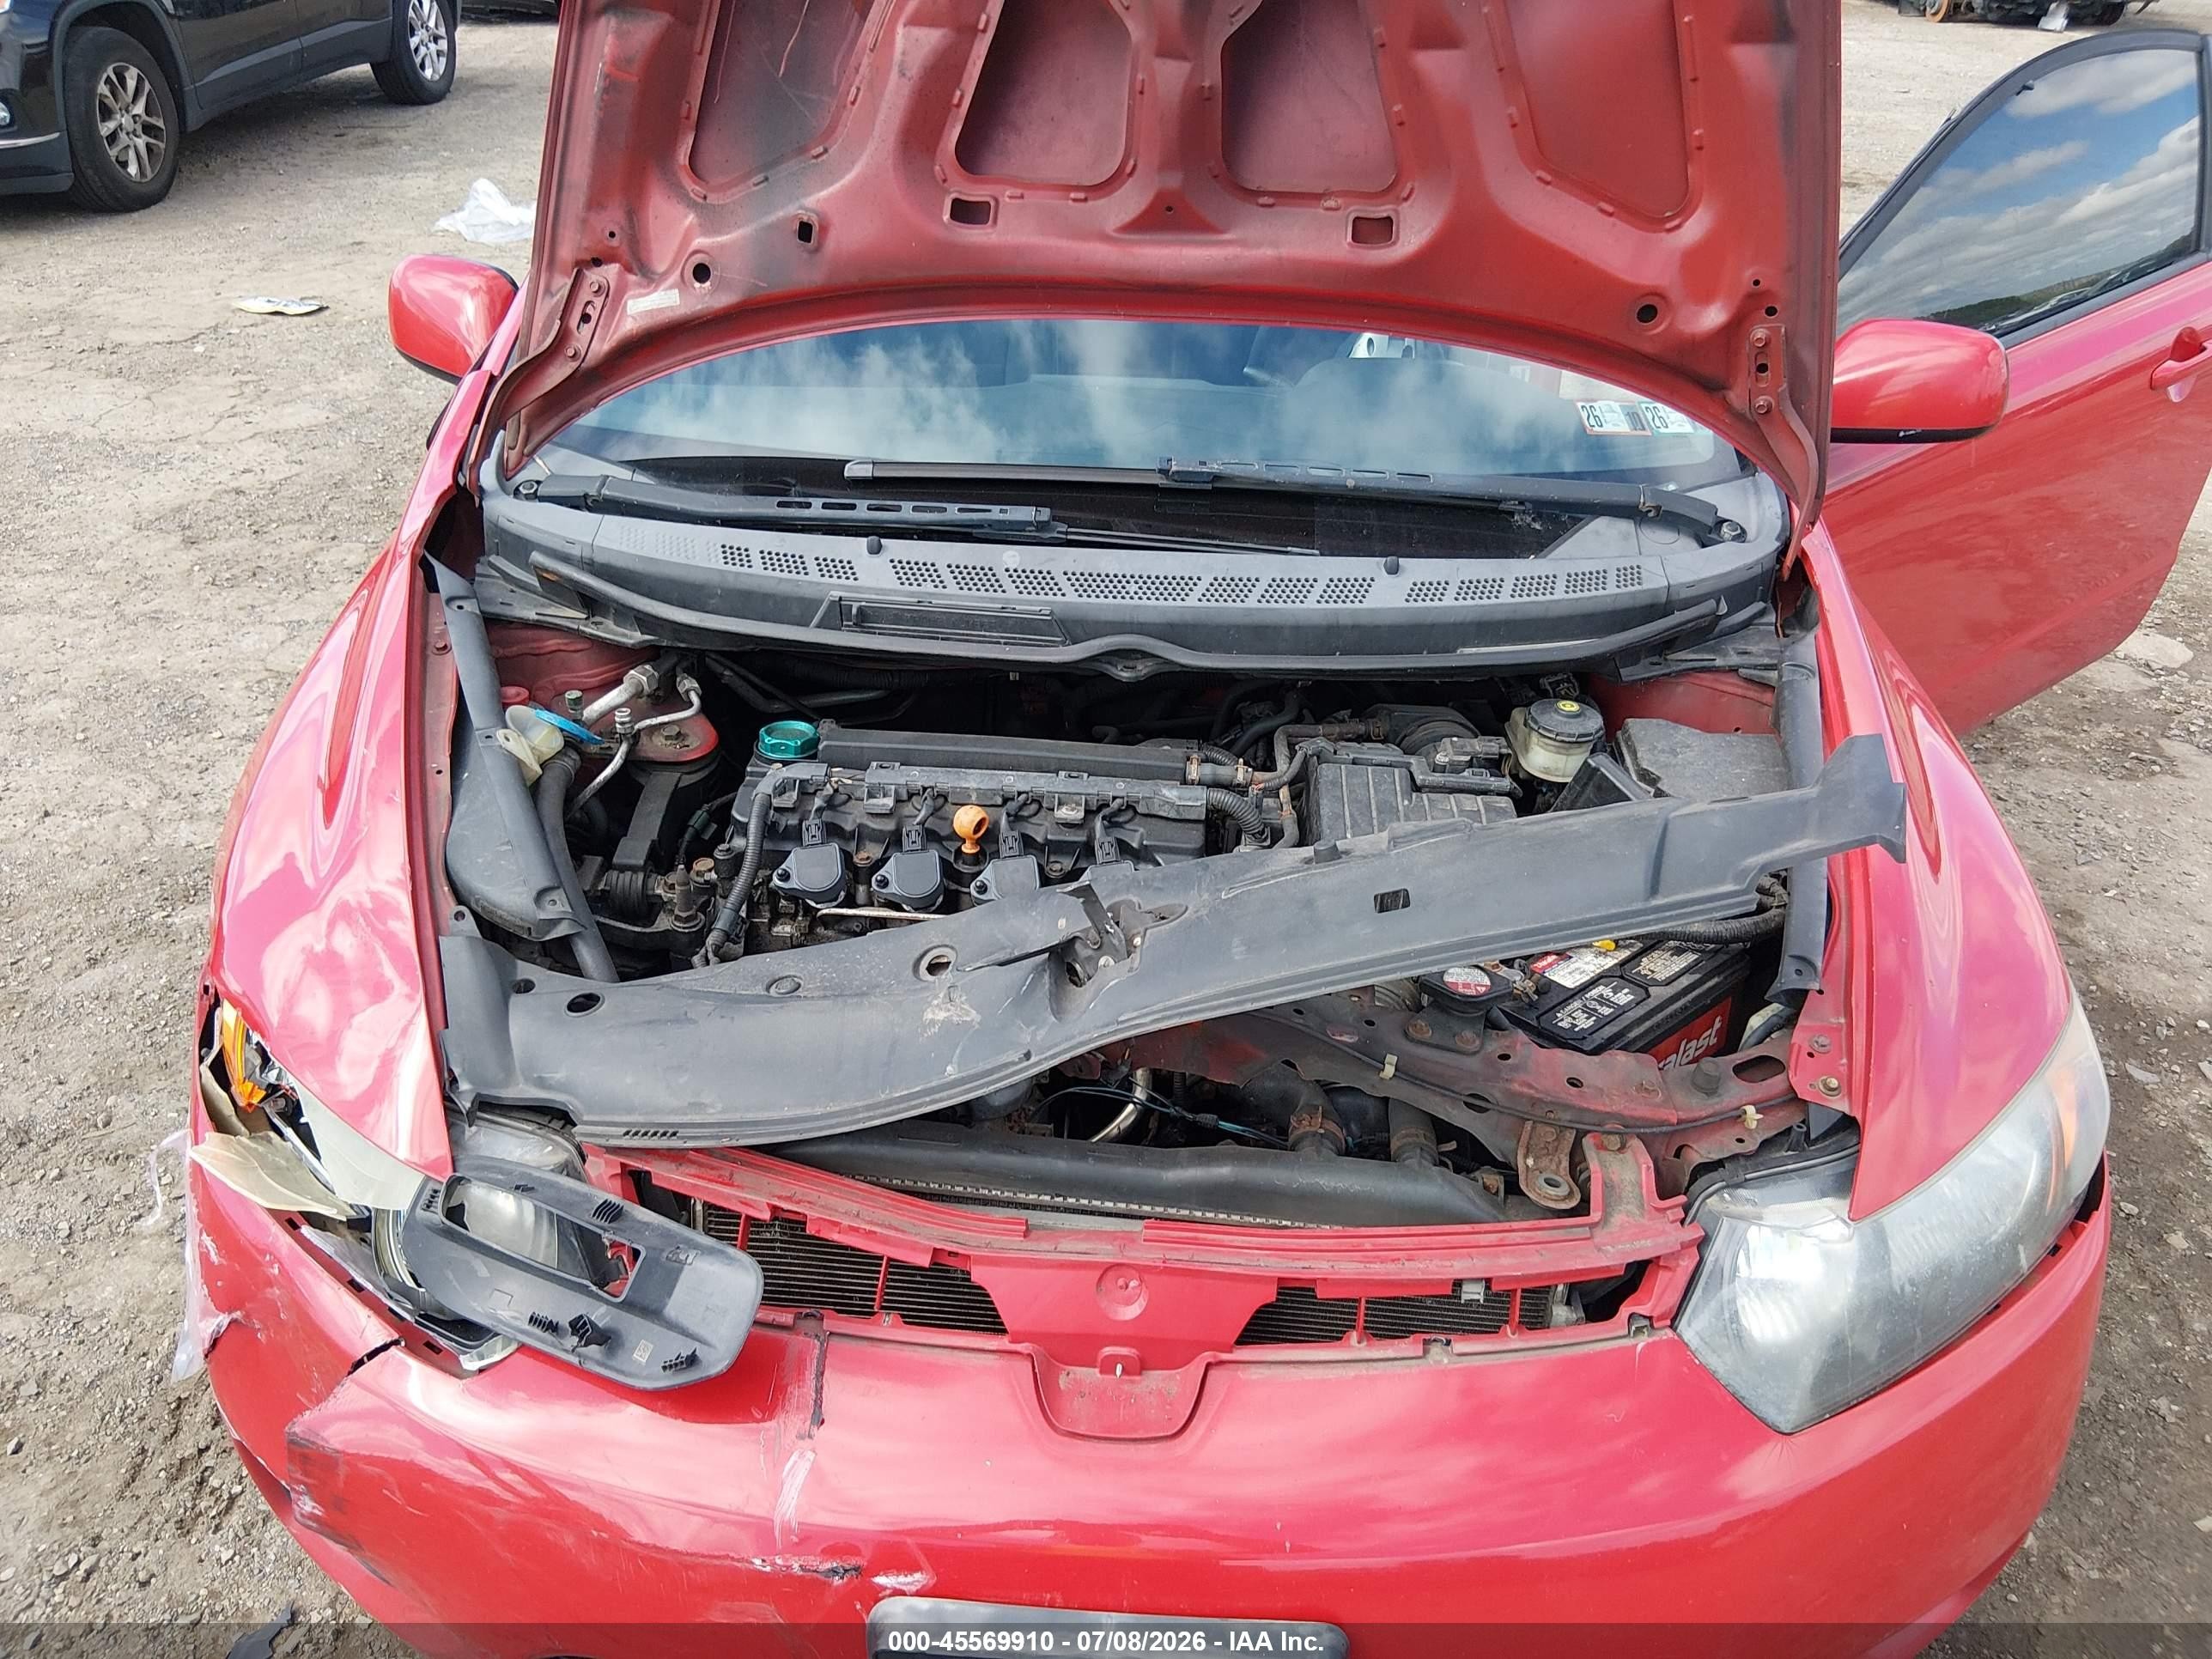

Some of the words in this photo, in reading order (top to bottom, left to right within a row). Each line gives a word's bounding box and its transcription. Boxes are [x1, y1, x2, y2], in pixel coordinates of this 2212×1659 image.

[1581, 404, 1603, 428] 26
[1645, 406, 1668, 428] 26
[1658, 1015, 1723, 1068] alast
